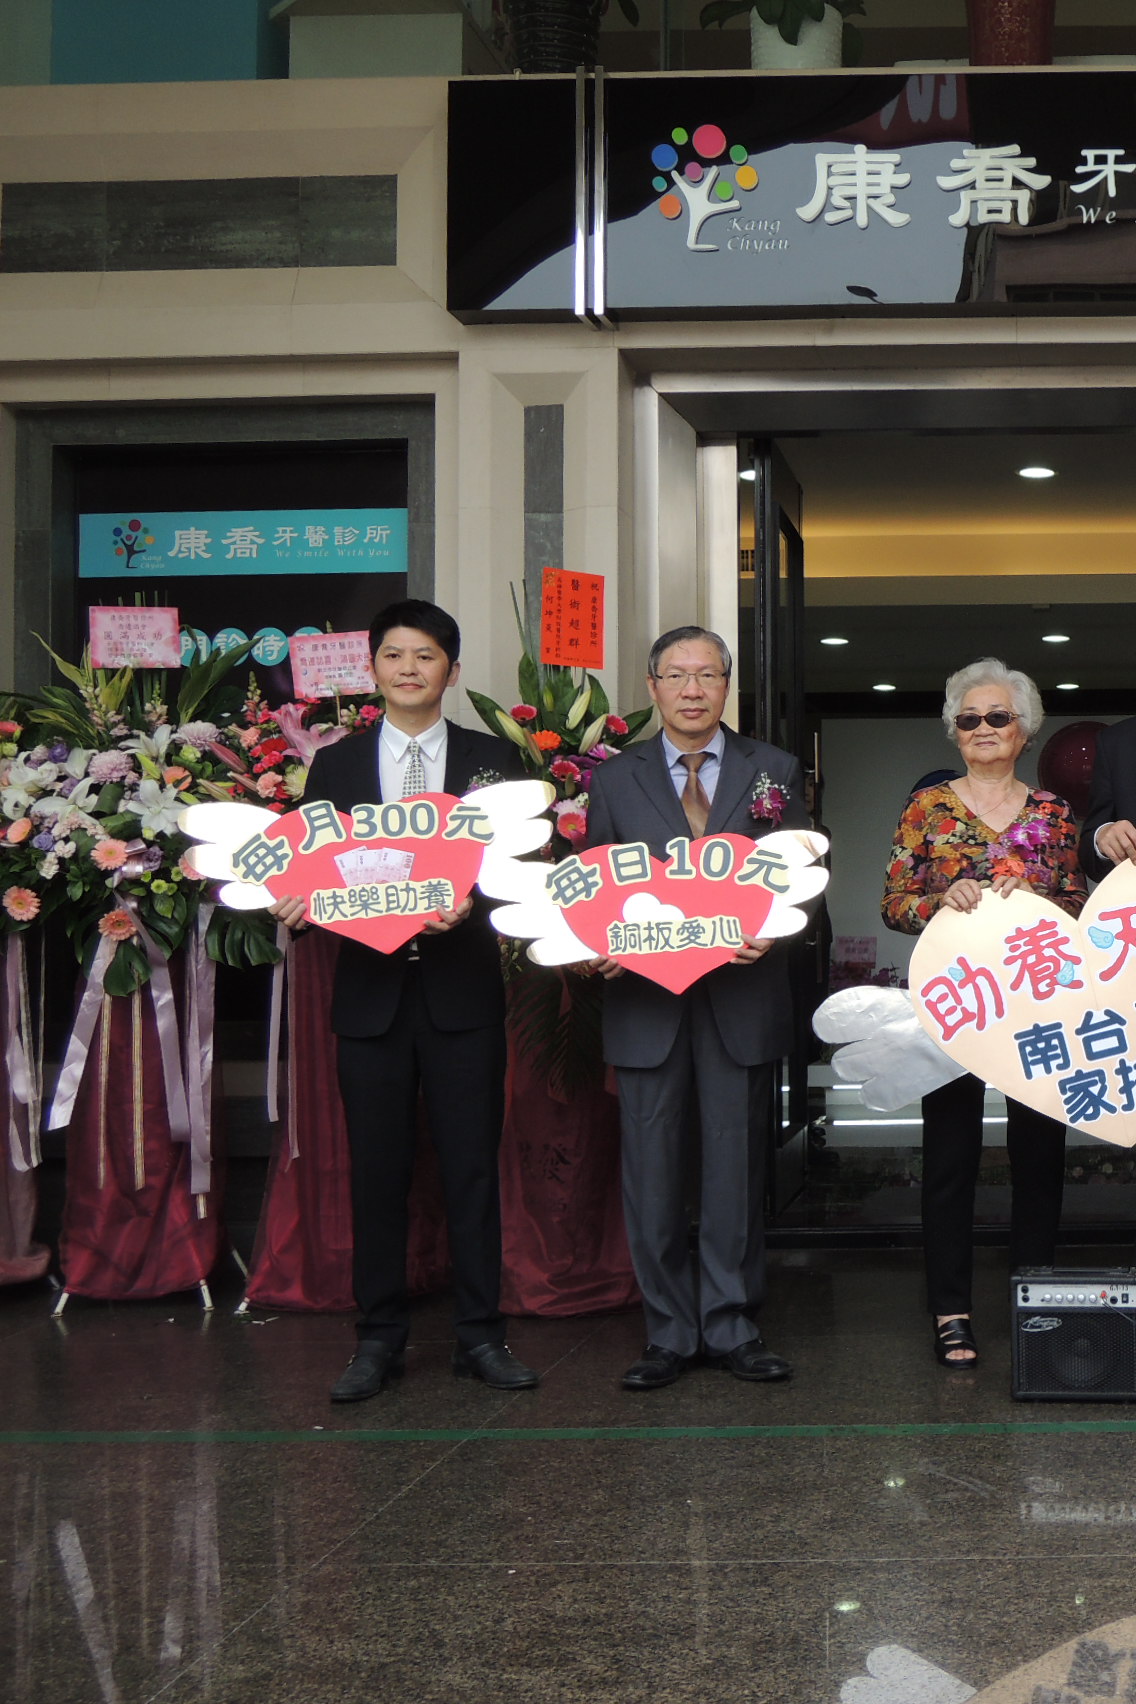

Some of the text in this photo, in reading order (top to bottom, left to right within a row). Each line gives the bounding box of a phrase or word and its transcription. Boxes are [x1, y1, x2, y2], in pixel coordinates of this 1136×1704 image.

[726, 217, 781, 235] Kang
[1075, 203, 1117, 225] We
[167, 524, 391, 560] 康喬牙醫診所
[232, 801, 495, 883] 每月300元
[546, 839, 791, 906] 每日10元
[312, 880, 453, 922] 快樂助養
[608, 915, 743, 953] 銅板愛心
